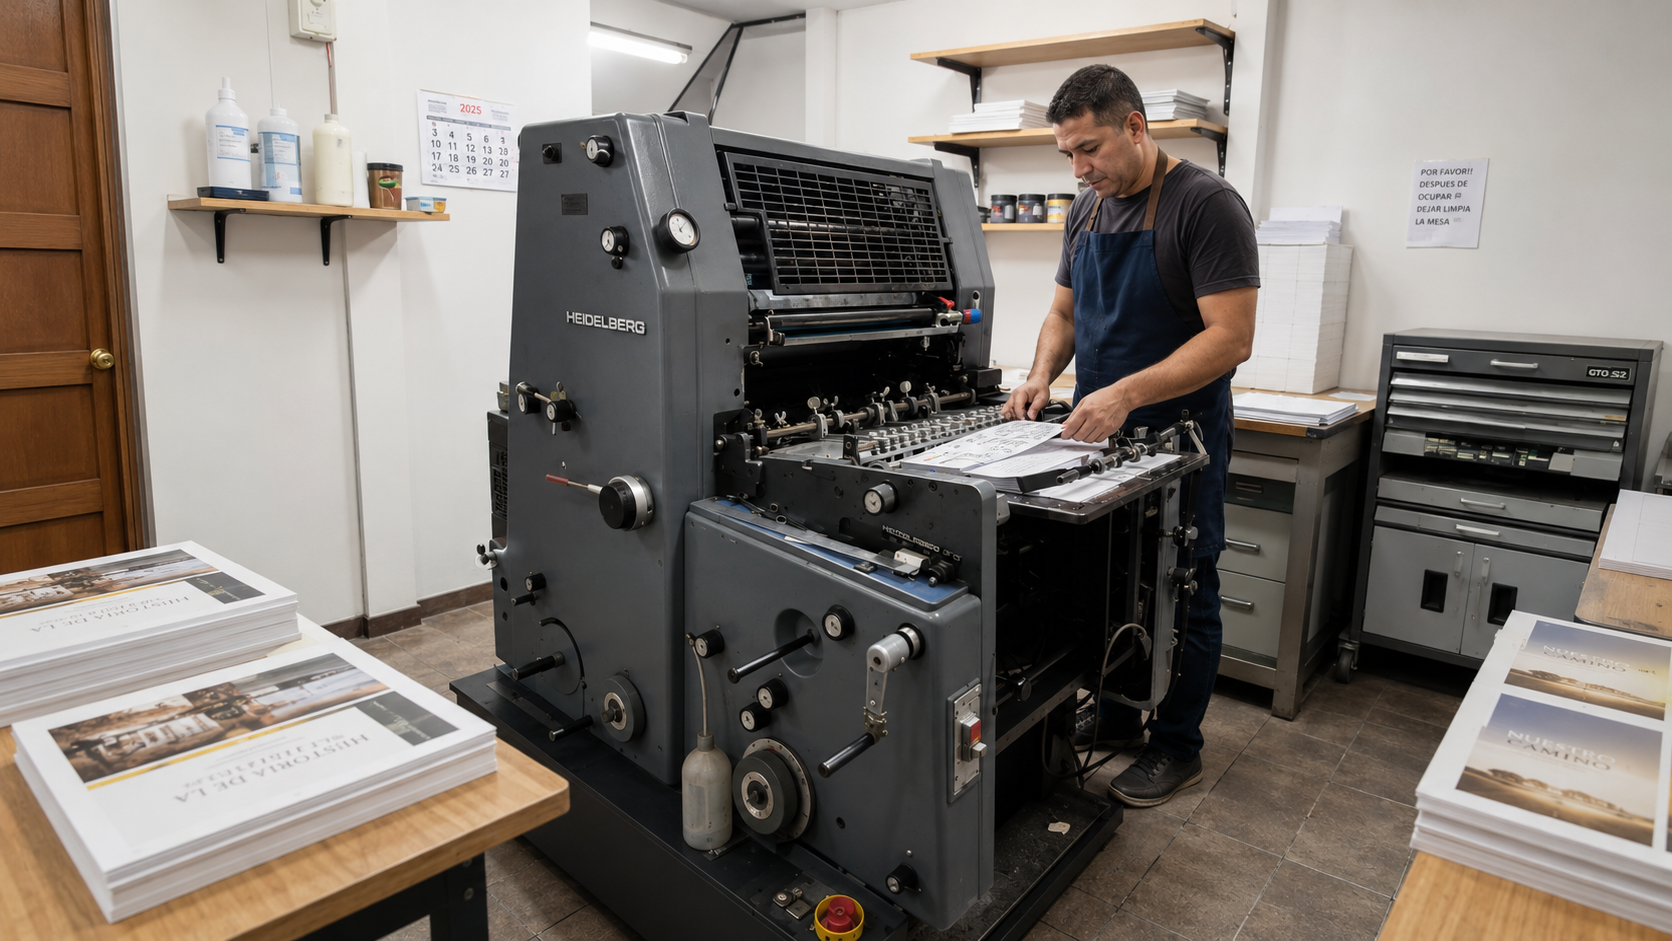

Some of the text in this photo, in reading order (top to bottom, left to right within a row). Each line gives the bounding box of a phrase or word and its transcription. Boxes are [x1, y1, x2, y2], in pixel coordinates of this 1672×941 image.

[460, 103, 482, 115] 2025
[432, 128, 438, 137] 3
[449, 131, 454, 139] 4
[466, 133, 472, 141] 5
[484, 135, 489, 143] 6
[431, 140, 441, 148] 10
[448, 142, 457, 150] 11
[466, 144, 475, 152] 12
[483, 146, 492, 154] 13
[432, 151, 441, 160] 17
[449, 154, 459, 162] 18
[466, 155, 476, 164] 19
[483, 157, 493, 166] 20
[449, 165, 460, 173] 25
[466, 166, 477, 175] 26
[483, 168, 493, 176] 27
[500, 170, 509, 178] 27
[1420, 168, 1473, 176] POR FAVOR!!
[1419, 180, 1455, 188] DESPUES
[566, 310, 646, 335] HEIDELBERG
[1588, 369, 1609, 378] GTO
[1507, 730, 1616, 763] NUESTRO
[1507, 740, 1610, 770] CAMINO
[212, 776, 247, 793] DE
[174, 788, 208, 804] LA
